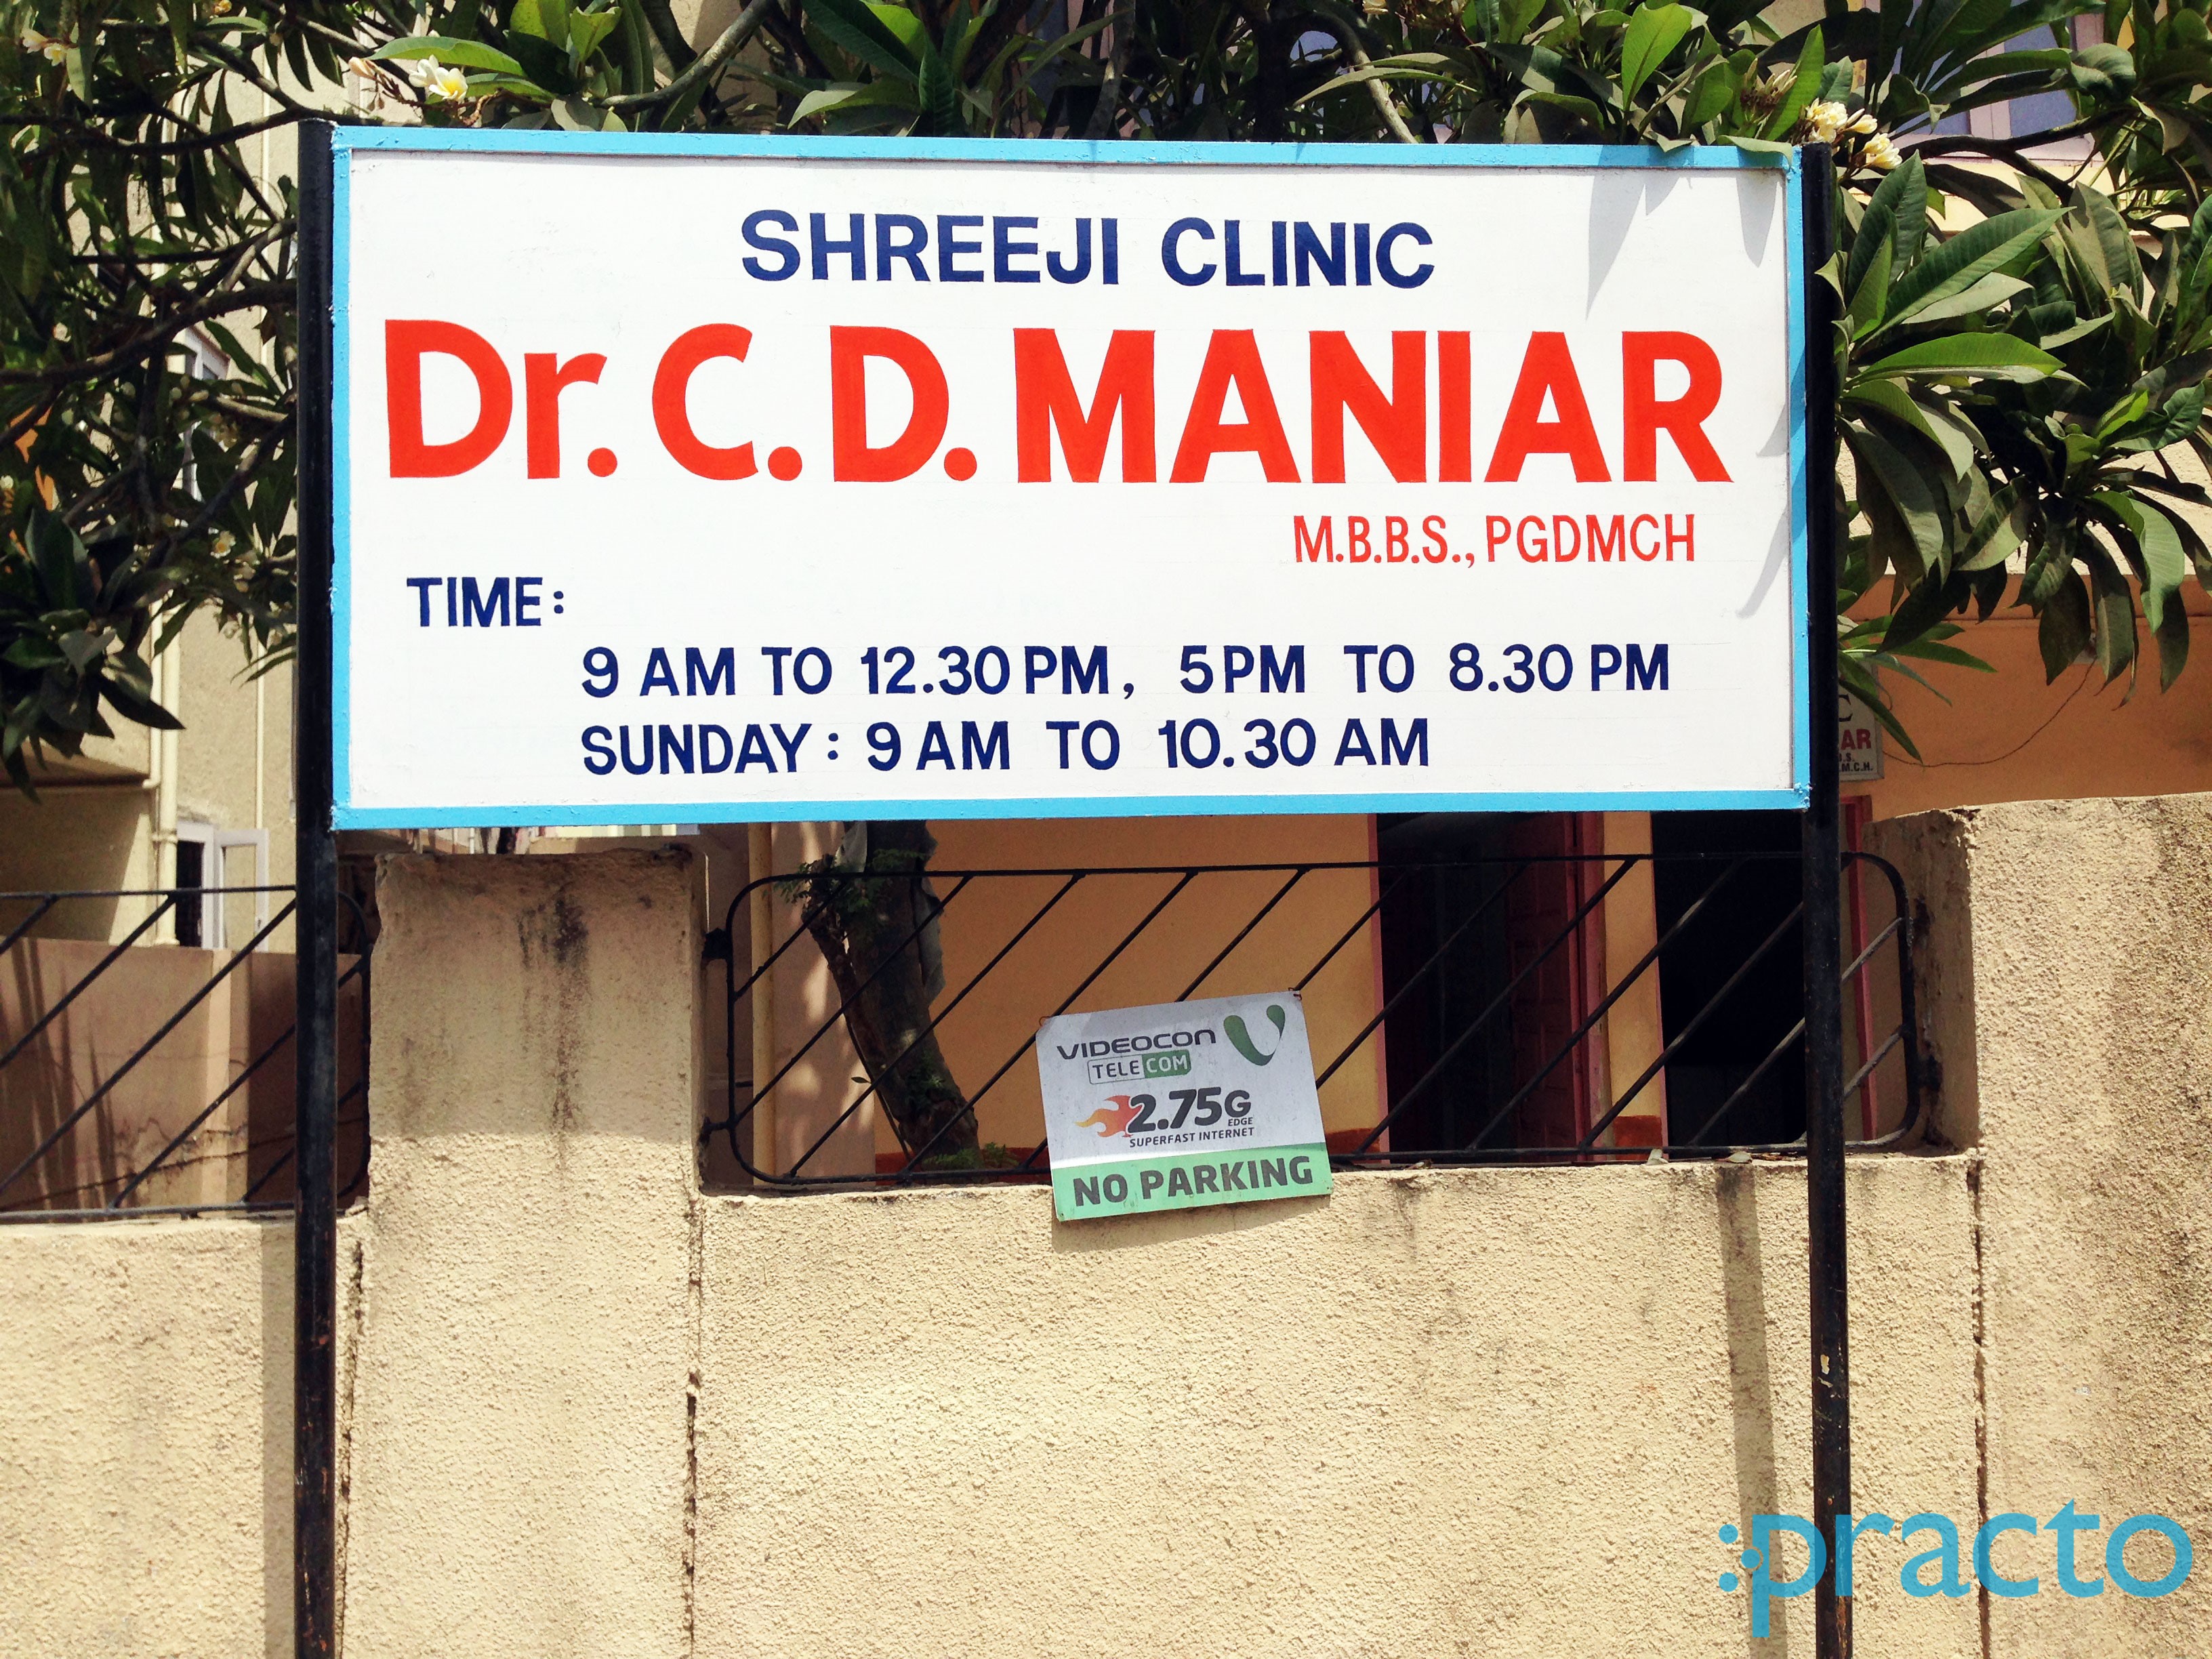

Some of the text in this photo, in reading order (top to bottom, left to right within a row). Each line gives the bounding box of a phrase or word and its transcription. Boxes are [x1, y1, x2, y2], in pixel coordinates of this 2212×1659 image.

[742, 210, 1435, 288] SHREEJI CLINIC
[386, 320, 618, 478] Dr.
[1013, 328, 1734, 483] MANIAR
[1294, 514, 1695, 567] M.B.B.S., PGDMCH
[406, 577, 564, 628] TIME:
[581, 647, 619, 698] 9
[639, 647, 737, 697] AM
[761, 647, 832, 697] TO
[1343, 644, 1414, 693] TO
[1449, 642, 1574, 693] 8.30
[1591, 643, 1669, 691] PM
[866, 722, 901, 771] 9
[916, 720, 1010, 771] AM
[1046, 719, 1120, 771] TO
[1158, 718, 1316, 769] 10.30
[1334, 718, 1429, 766] AM
[1092, 1054, 1188, 1079] TELECOM
[1127, 1087, 1252, 1134] 2.75G
[1228, 1117, 1253, 1127] EDGE
[1130, 1127, 1254, 1147] SUPERFAST INTERNET
[1073, 1156, 1313, 1207] NO PARKING
